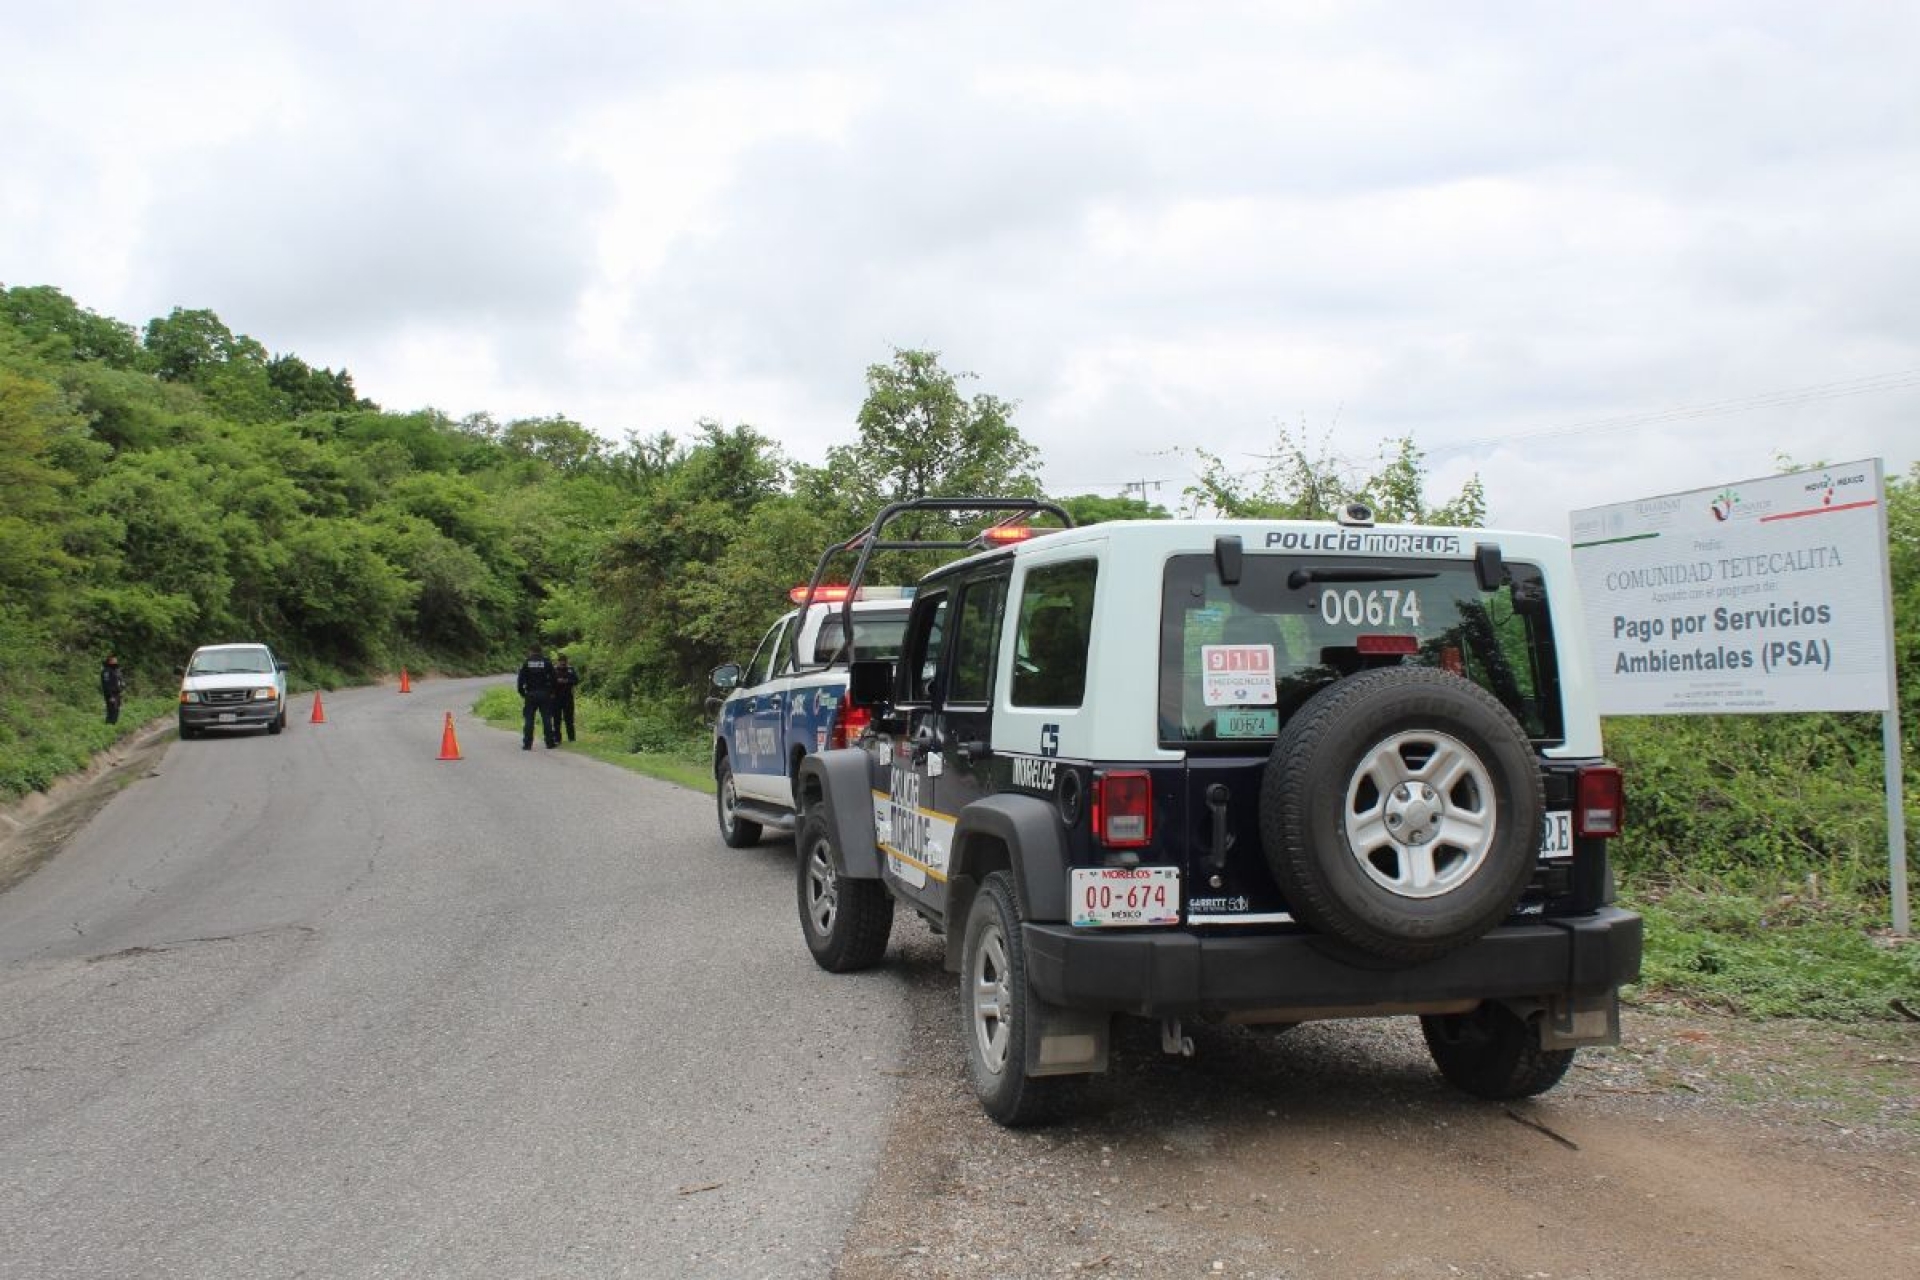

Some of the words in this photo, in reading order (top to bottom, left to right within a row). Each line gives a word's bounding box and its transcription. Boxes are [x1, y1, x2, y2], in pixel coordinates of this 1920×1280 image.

[1365, 534, 1460, 553] MORELOS
[1606, 562, 1713, 591] COMUNIDAD
[1718, 546, 1844, 579] TETECALITA
[1321, 588, 1421, 627] 00674
[1613, 615, 1665, 642] Pago
[1671, 613, 1707, 640] por
[1714, 601, 1831, 631] Servicios
[1210, 651, 1266, 670] 911
[1615, 646, 1754, 674] Ambientales
[1762, 638, 1831, 674] (PSA)
[1101, 869, 1152, 879] MORELOS
[1086, 885, 1166, 910] 00-674
